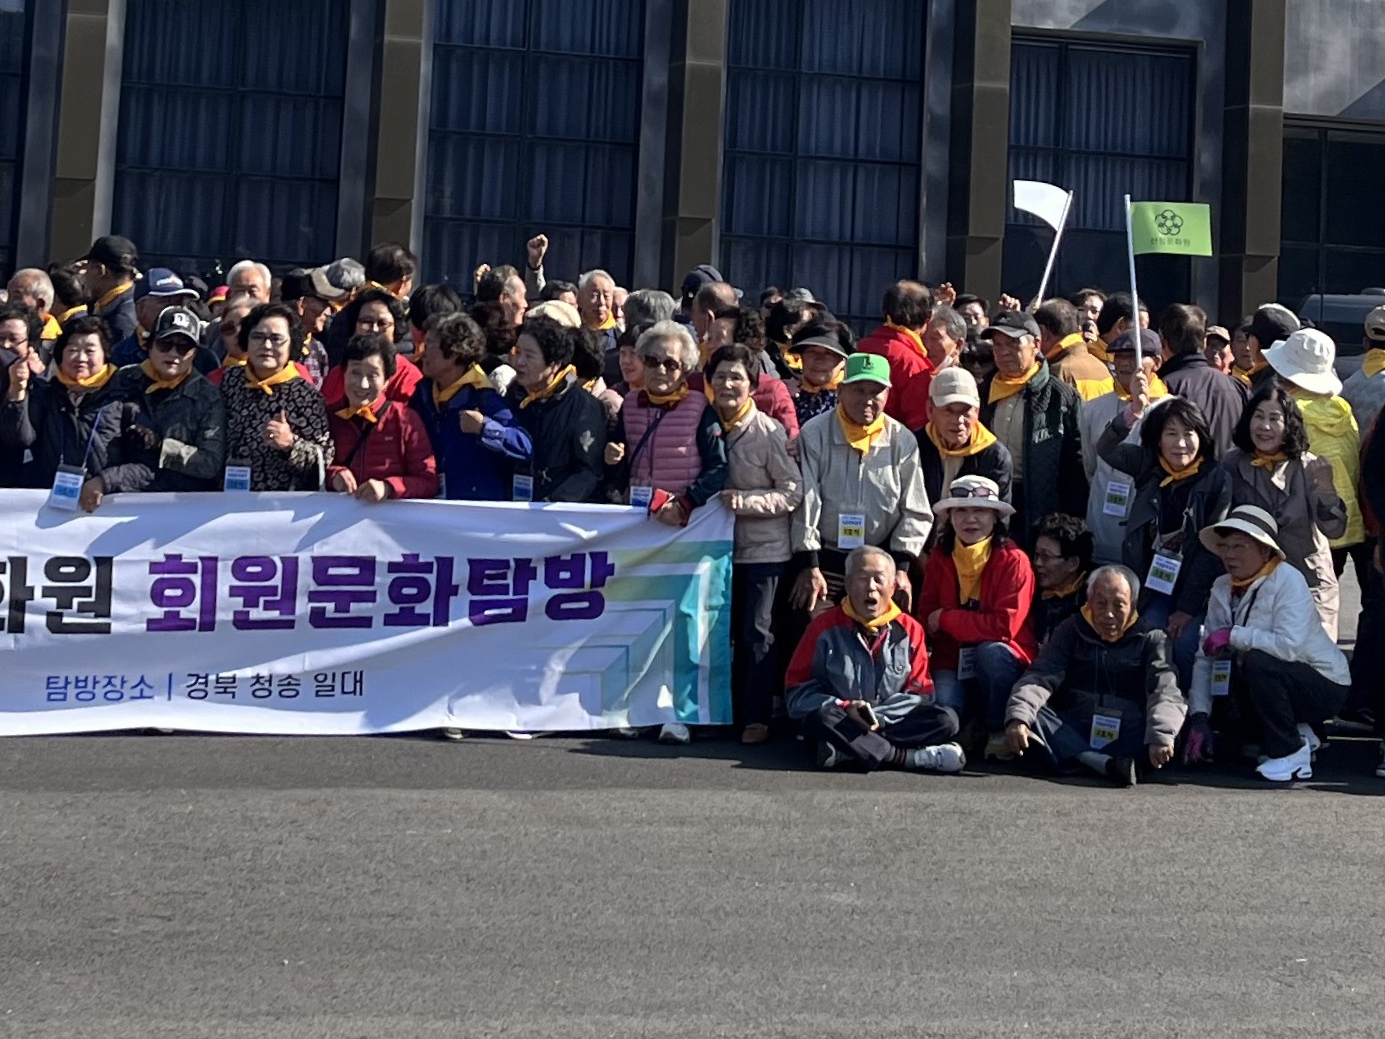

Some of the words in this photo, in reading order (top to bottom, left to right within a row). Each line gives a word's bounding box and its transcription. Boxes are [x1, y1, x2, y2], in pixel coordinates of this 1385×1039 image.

[145, 550, 615, 634] 회원문화탐방
[45, 673, 155, 702] 탐방장소
[184, 672, 238, 700] 경북
[249, 671, 302, 700] 청송
[313, 670, 365, 699] 일대
